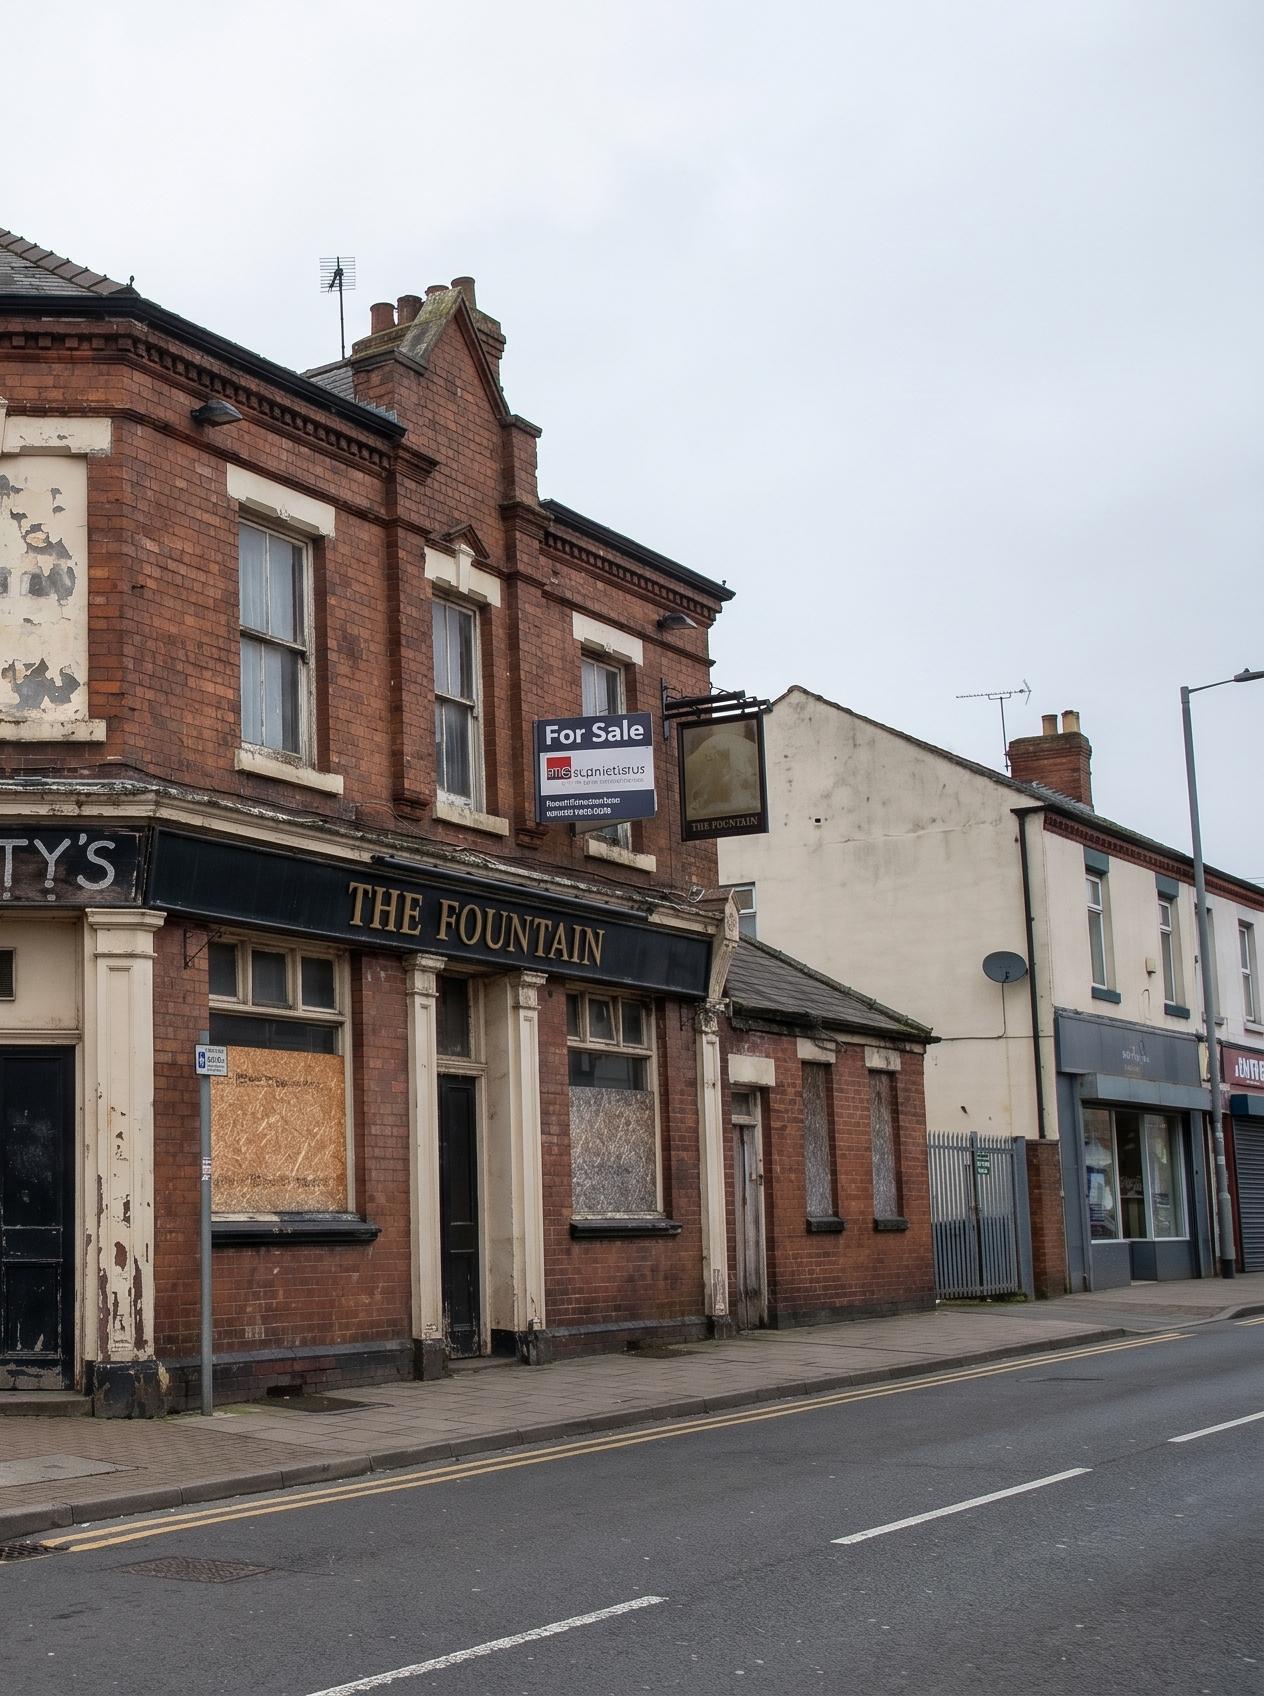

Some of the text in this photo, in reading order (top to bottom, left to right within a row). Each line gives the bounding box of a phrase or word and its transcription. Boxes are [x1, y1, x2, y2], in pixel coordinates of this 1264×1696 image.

[545, 719, 644, 745] For Sale
[691, 821, 710, 832] THE
[348, 881, 605, 967] THE FOUNTAIN
